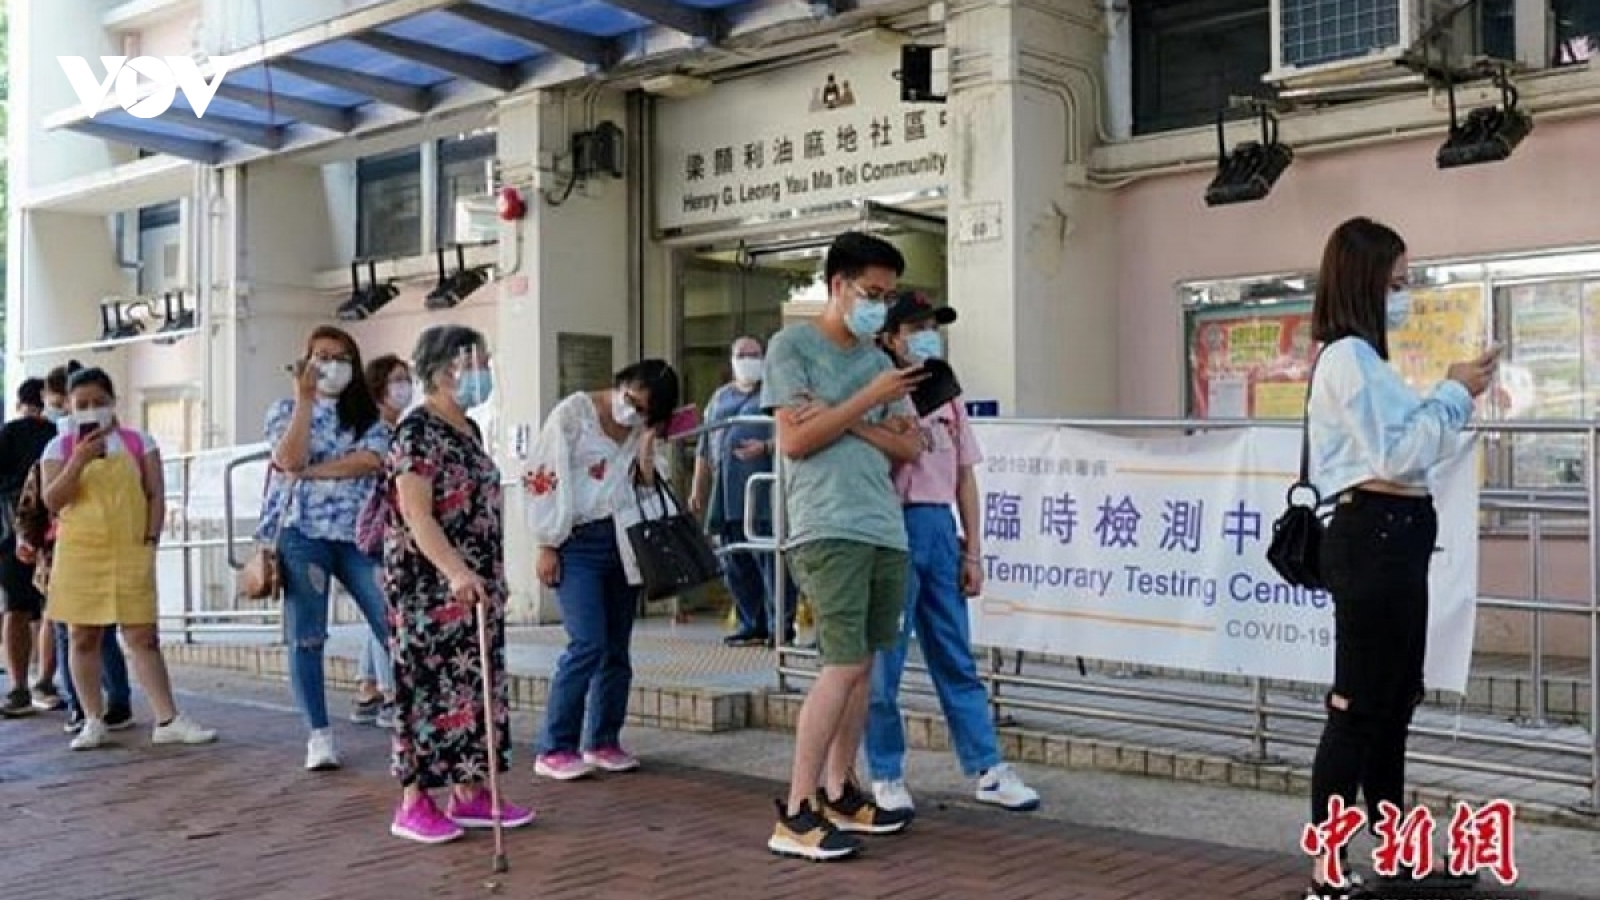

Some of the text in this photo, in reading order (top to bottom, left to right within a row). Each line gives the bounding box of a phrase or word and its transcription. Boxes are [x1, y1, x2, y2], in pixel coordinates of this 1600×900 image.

[682, 193, 718, 213] Henry
[739, 182, 780, 203] Leong
[785, 176, 808, 193] Yau
[811, 171, 833, 190] Ma
[836, 164, 857, 187] Tei
[861, 152, 947, 183] Community
[983, 554, 1113, 597] Temporary
[1123, 564, 1217, 607] Testing
[1227, 618, 1330, 648] COVID-19
